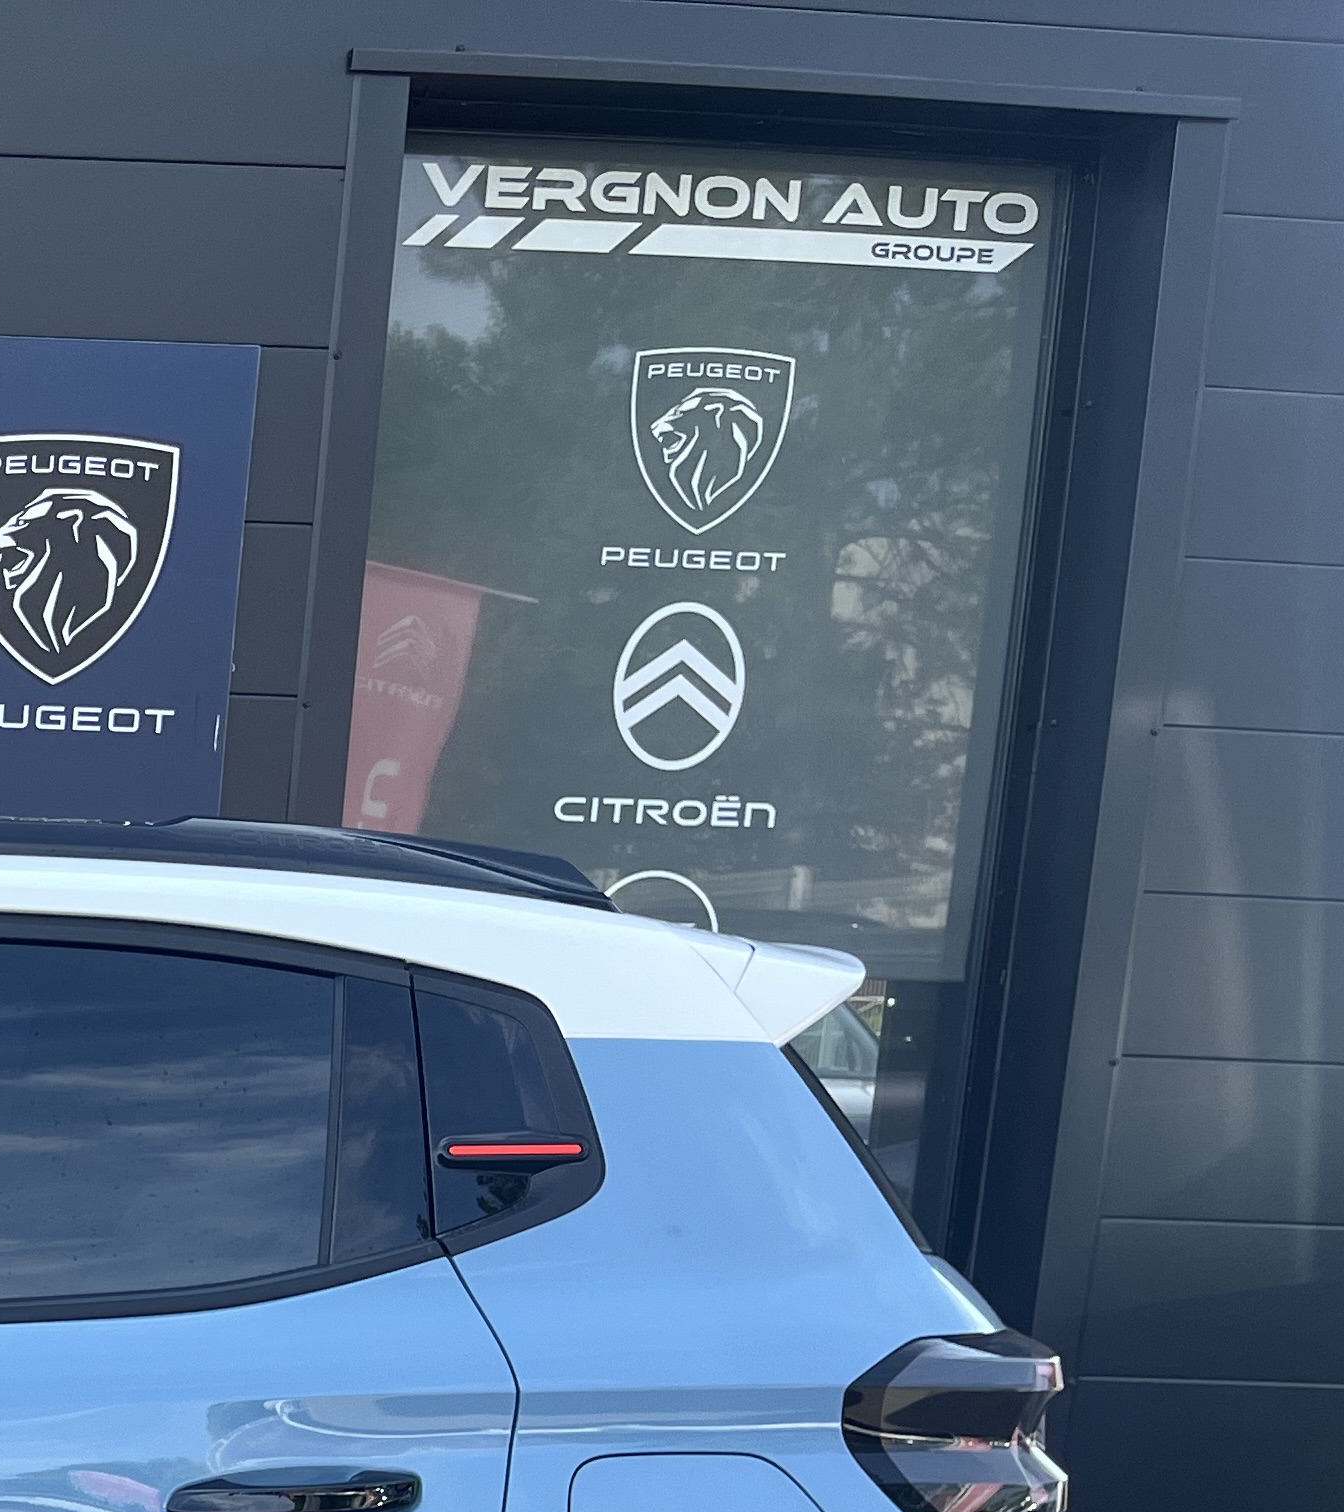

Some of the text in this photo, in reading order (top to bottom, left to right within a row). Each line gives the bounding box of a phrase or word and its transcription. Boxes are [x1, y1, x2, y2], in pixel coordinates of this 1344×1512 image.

[422, 162, 1040, 236] VERGNON AUTO
[870, 241, 994, 265] GROUPE
[647, 361, 781, 384] PEUGEOT
[600, 546, 787, 573] PEUGEOT
[554, 795, 777, 829] CITROËN
